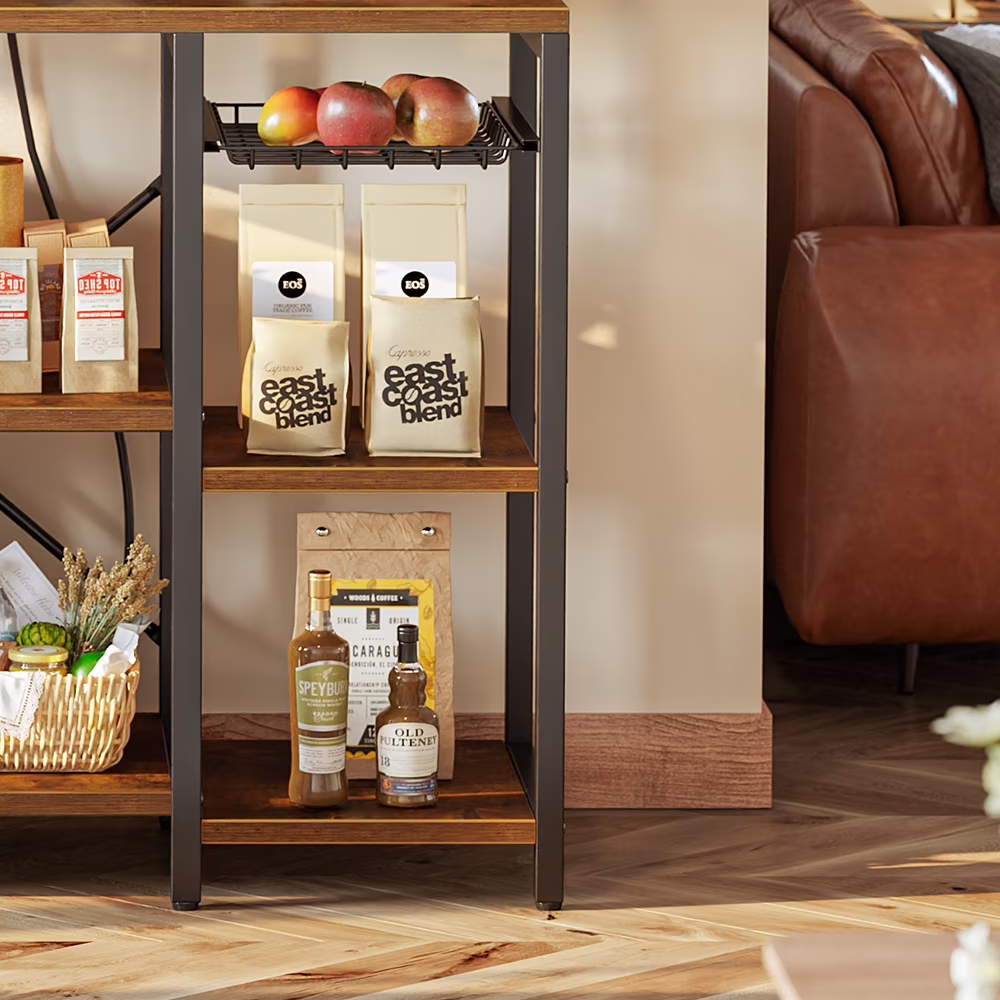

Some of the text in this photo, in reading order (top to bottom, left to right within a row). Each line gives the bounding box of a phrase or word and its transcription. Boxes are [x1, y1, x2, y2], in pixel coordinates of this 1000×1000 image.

[388, 345, 431, 361] Capresso
[264, 361, 303, 376] Capresso
[384, 353, 457, 386] east
[261, 368, 326, 397] east
[382, 371, 468, 407] coast
[259, 383, 337, 414] coast
[400, 396, 462, 424] blend
[275, 405, 331, 429] blend
[380, 735, 437, 746] PULTENEY
[395, 728, 424, 737] OLD
[381, 755, 390, 767] 18
